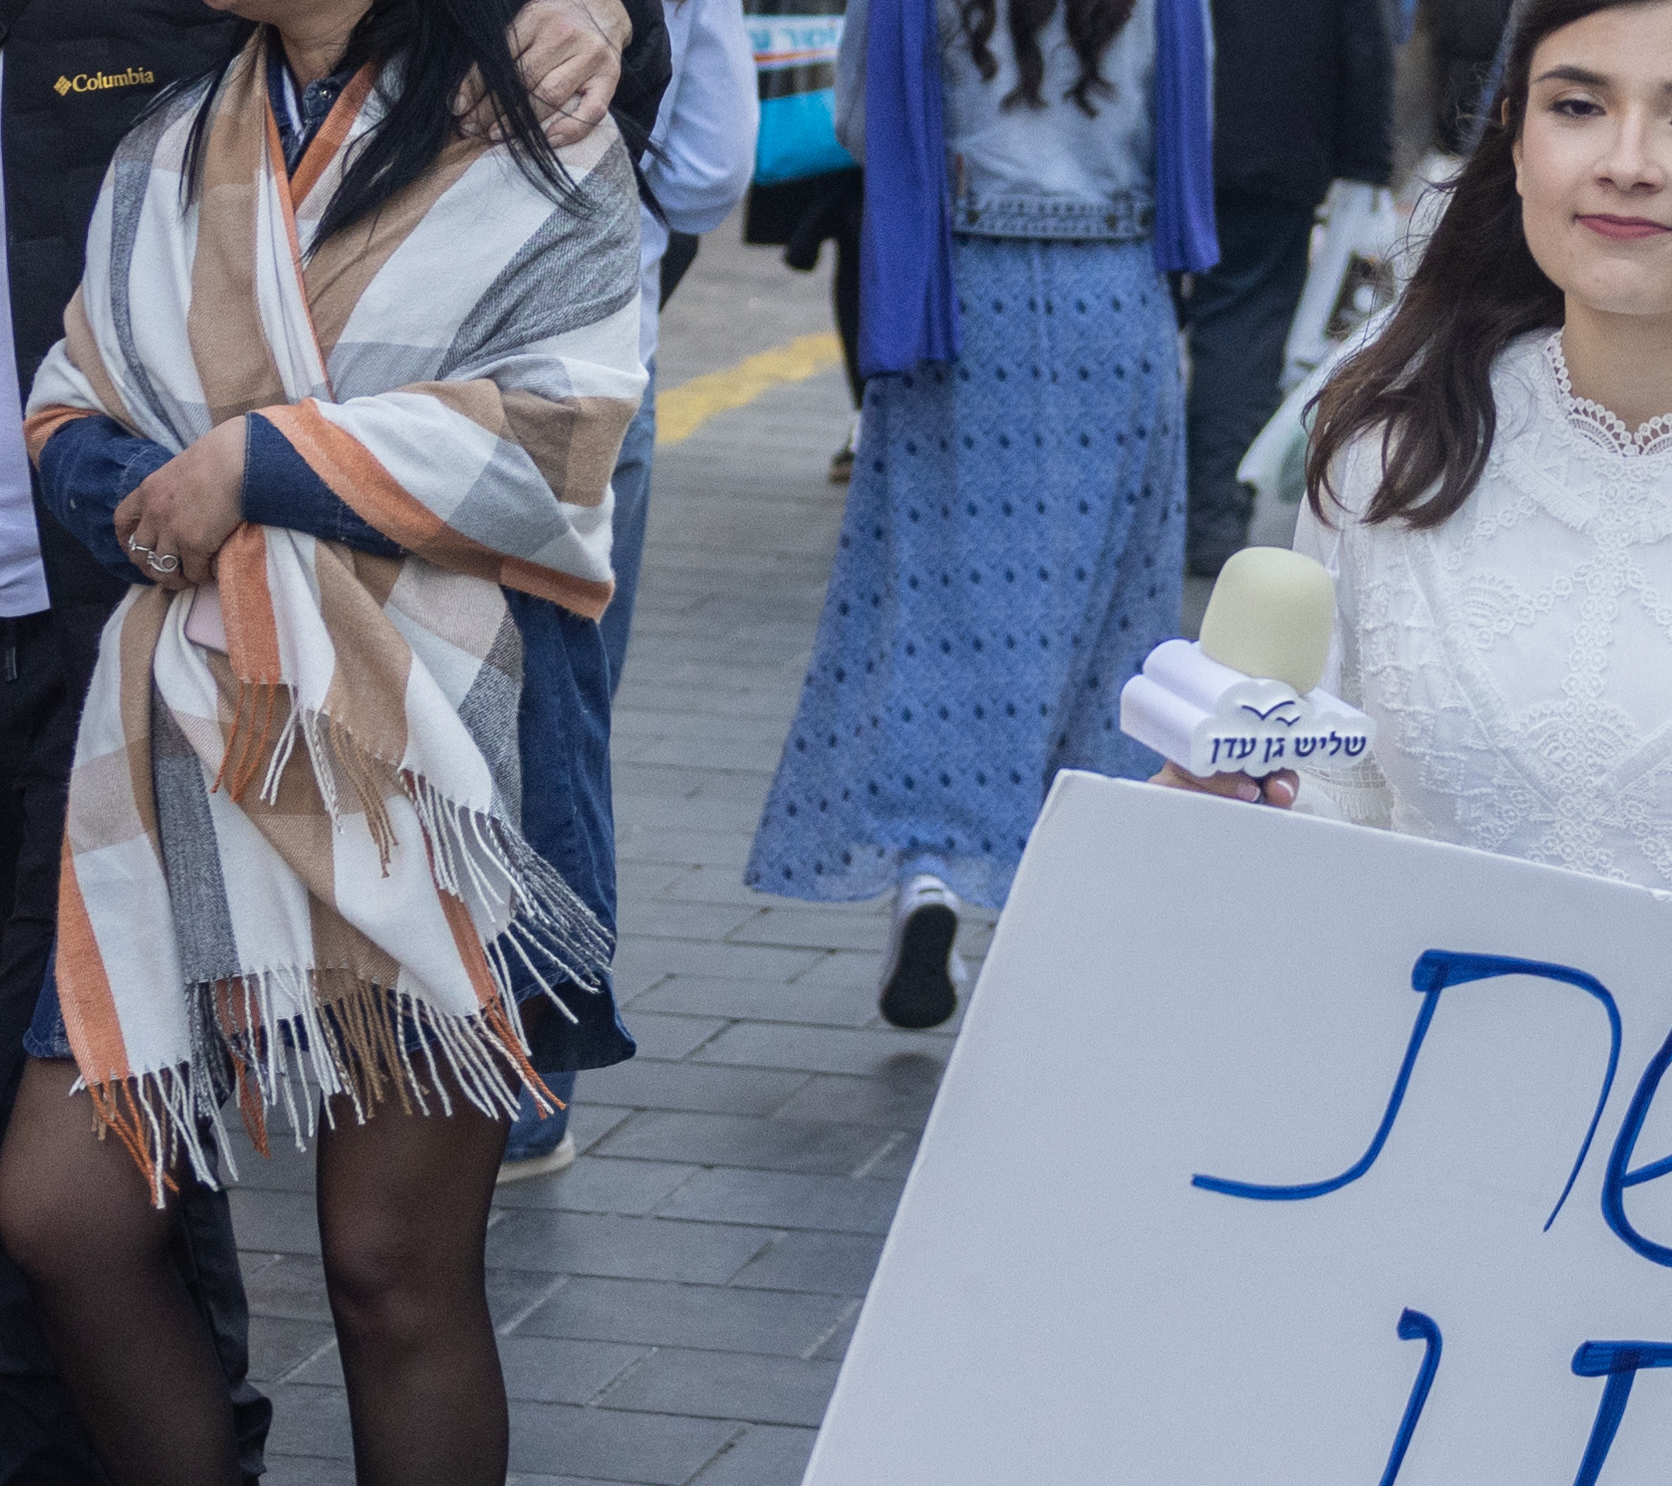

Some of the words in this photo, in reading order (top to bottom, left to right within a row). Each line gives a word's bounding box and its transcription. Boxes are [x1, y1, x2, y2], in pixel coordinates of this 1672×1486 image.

[72, 67, 155, 93] Columbia
[1211, 736, 1257, 764] עדן
[1263, 736, 1286, 763] גן
[1294, 730, 1366, 758] שליש
